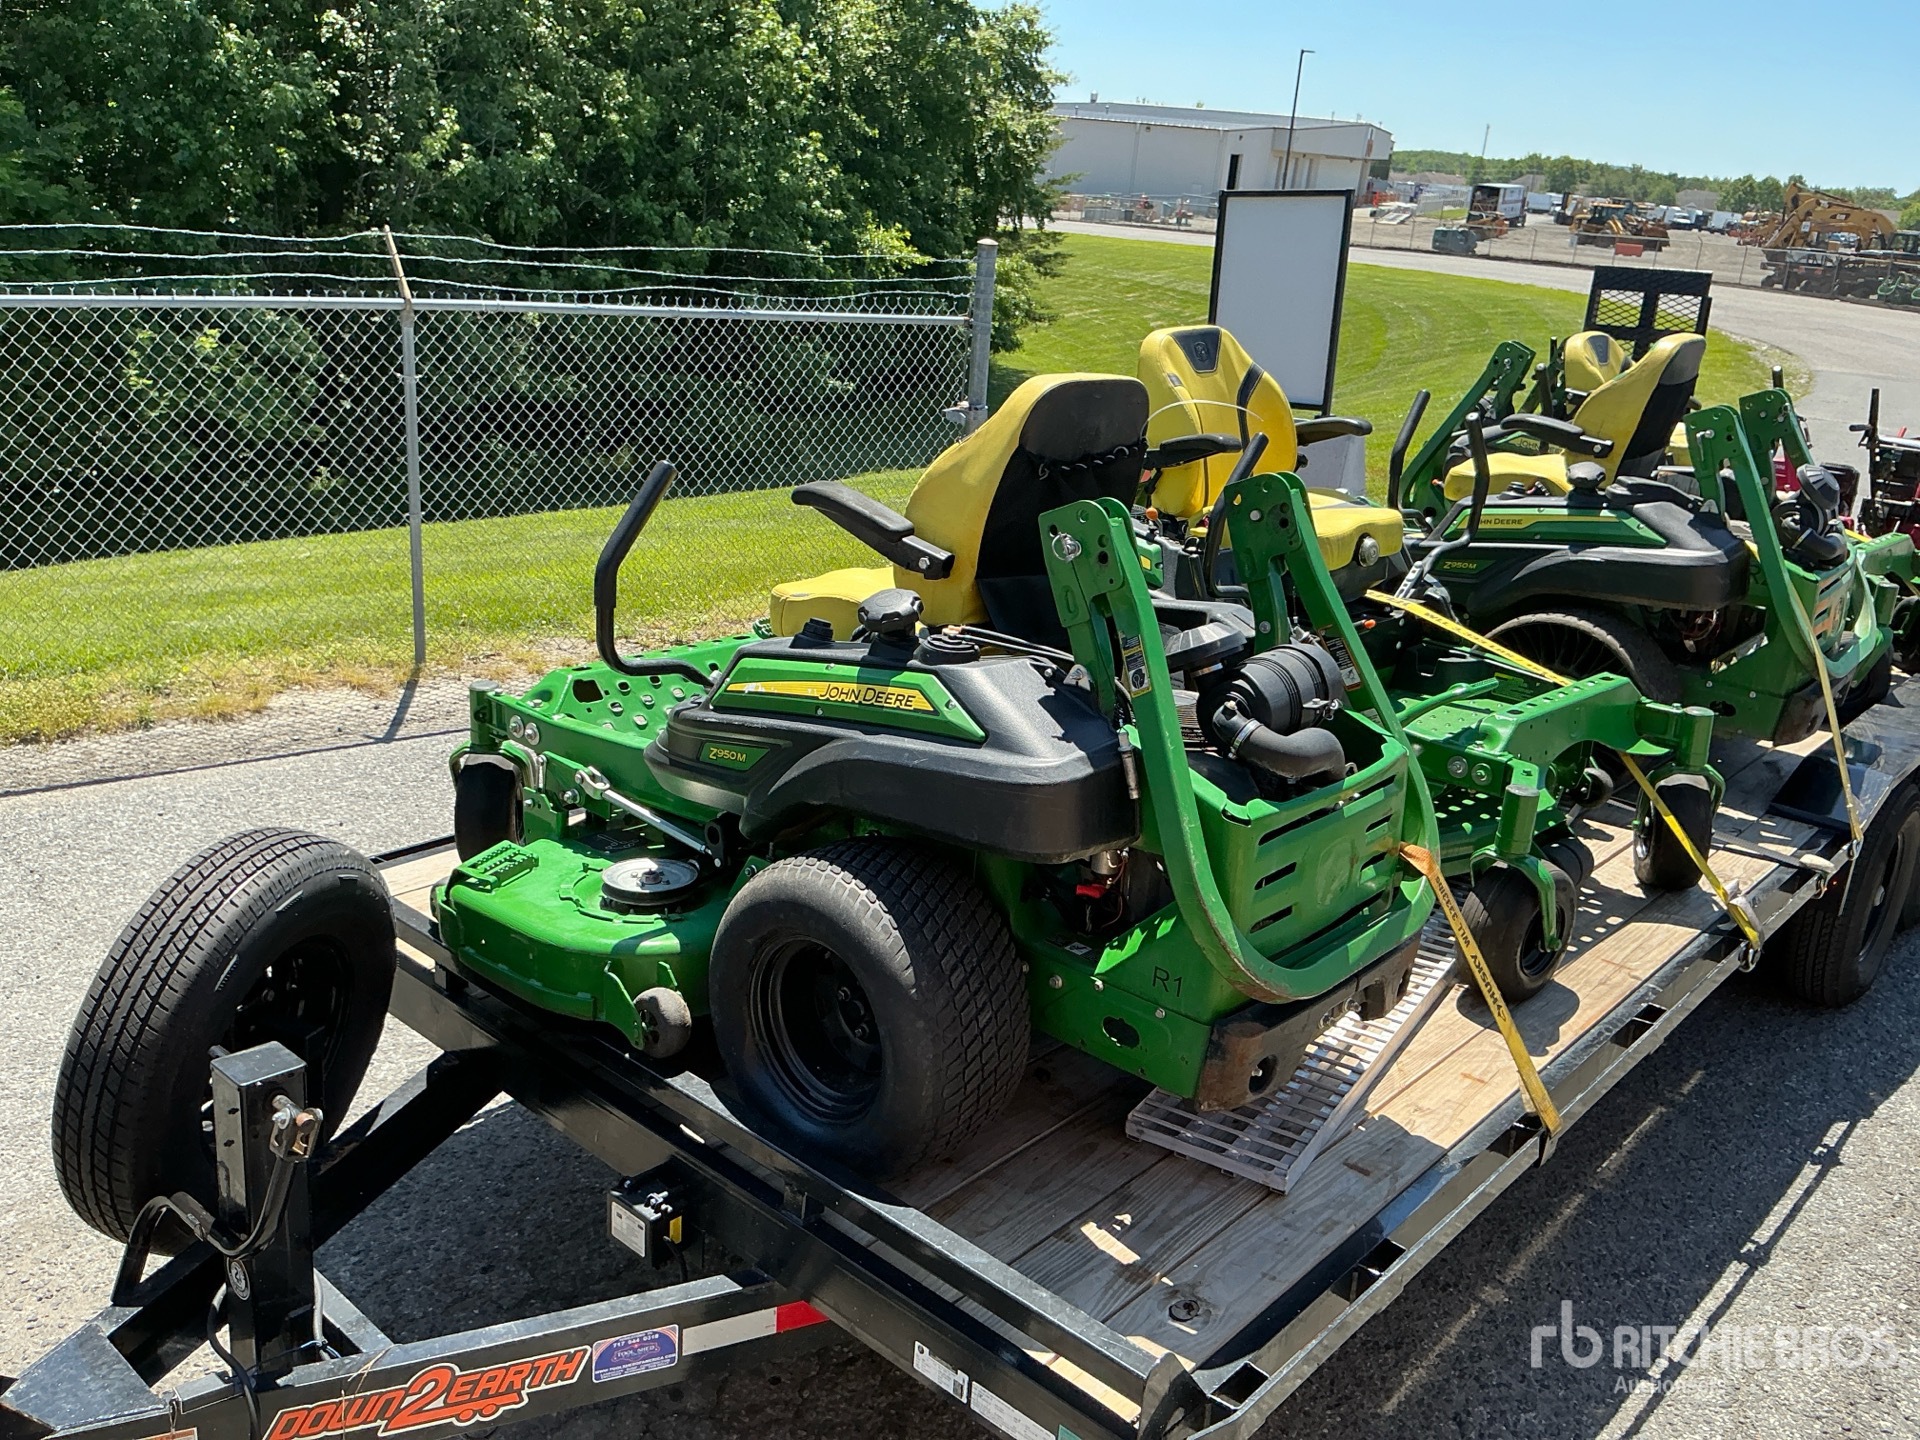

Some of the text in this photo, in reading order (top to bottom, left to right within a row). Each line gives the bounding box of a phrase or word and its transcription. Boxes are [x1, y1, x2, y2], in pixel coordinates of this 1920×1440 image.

[1493, 517, 1524, 526] DEERE
[1443, 561, 1478, 570] Z950M
[819, 683, 917, 708] JOHN DEERE
[709, 747, 747, 763] Z950M
[1457, 922, 1472, 949] WLL
[1152, 965, 1183, 998] R1
[1470, 954, 1499, 1006] HUSKY
